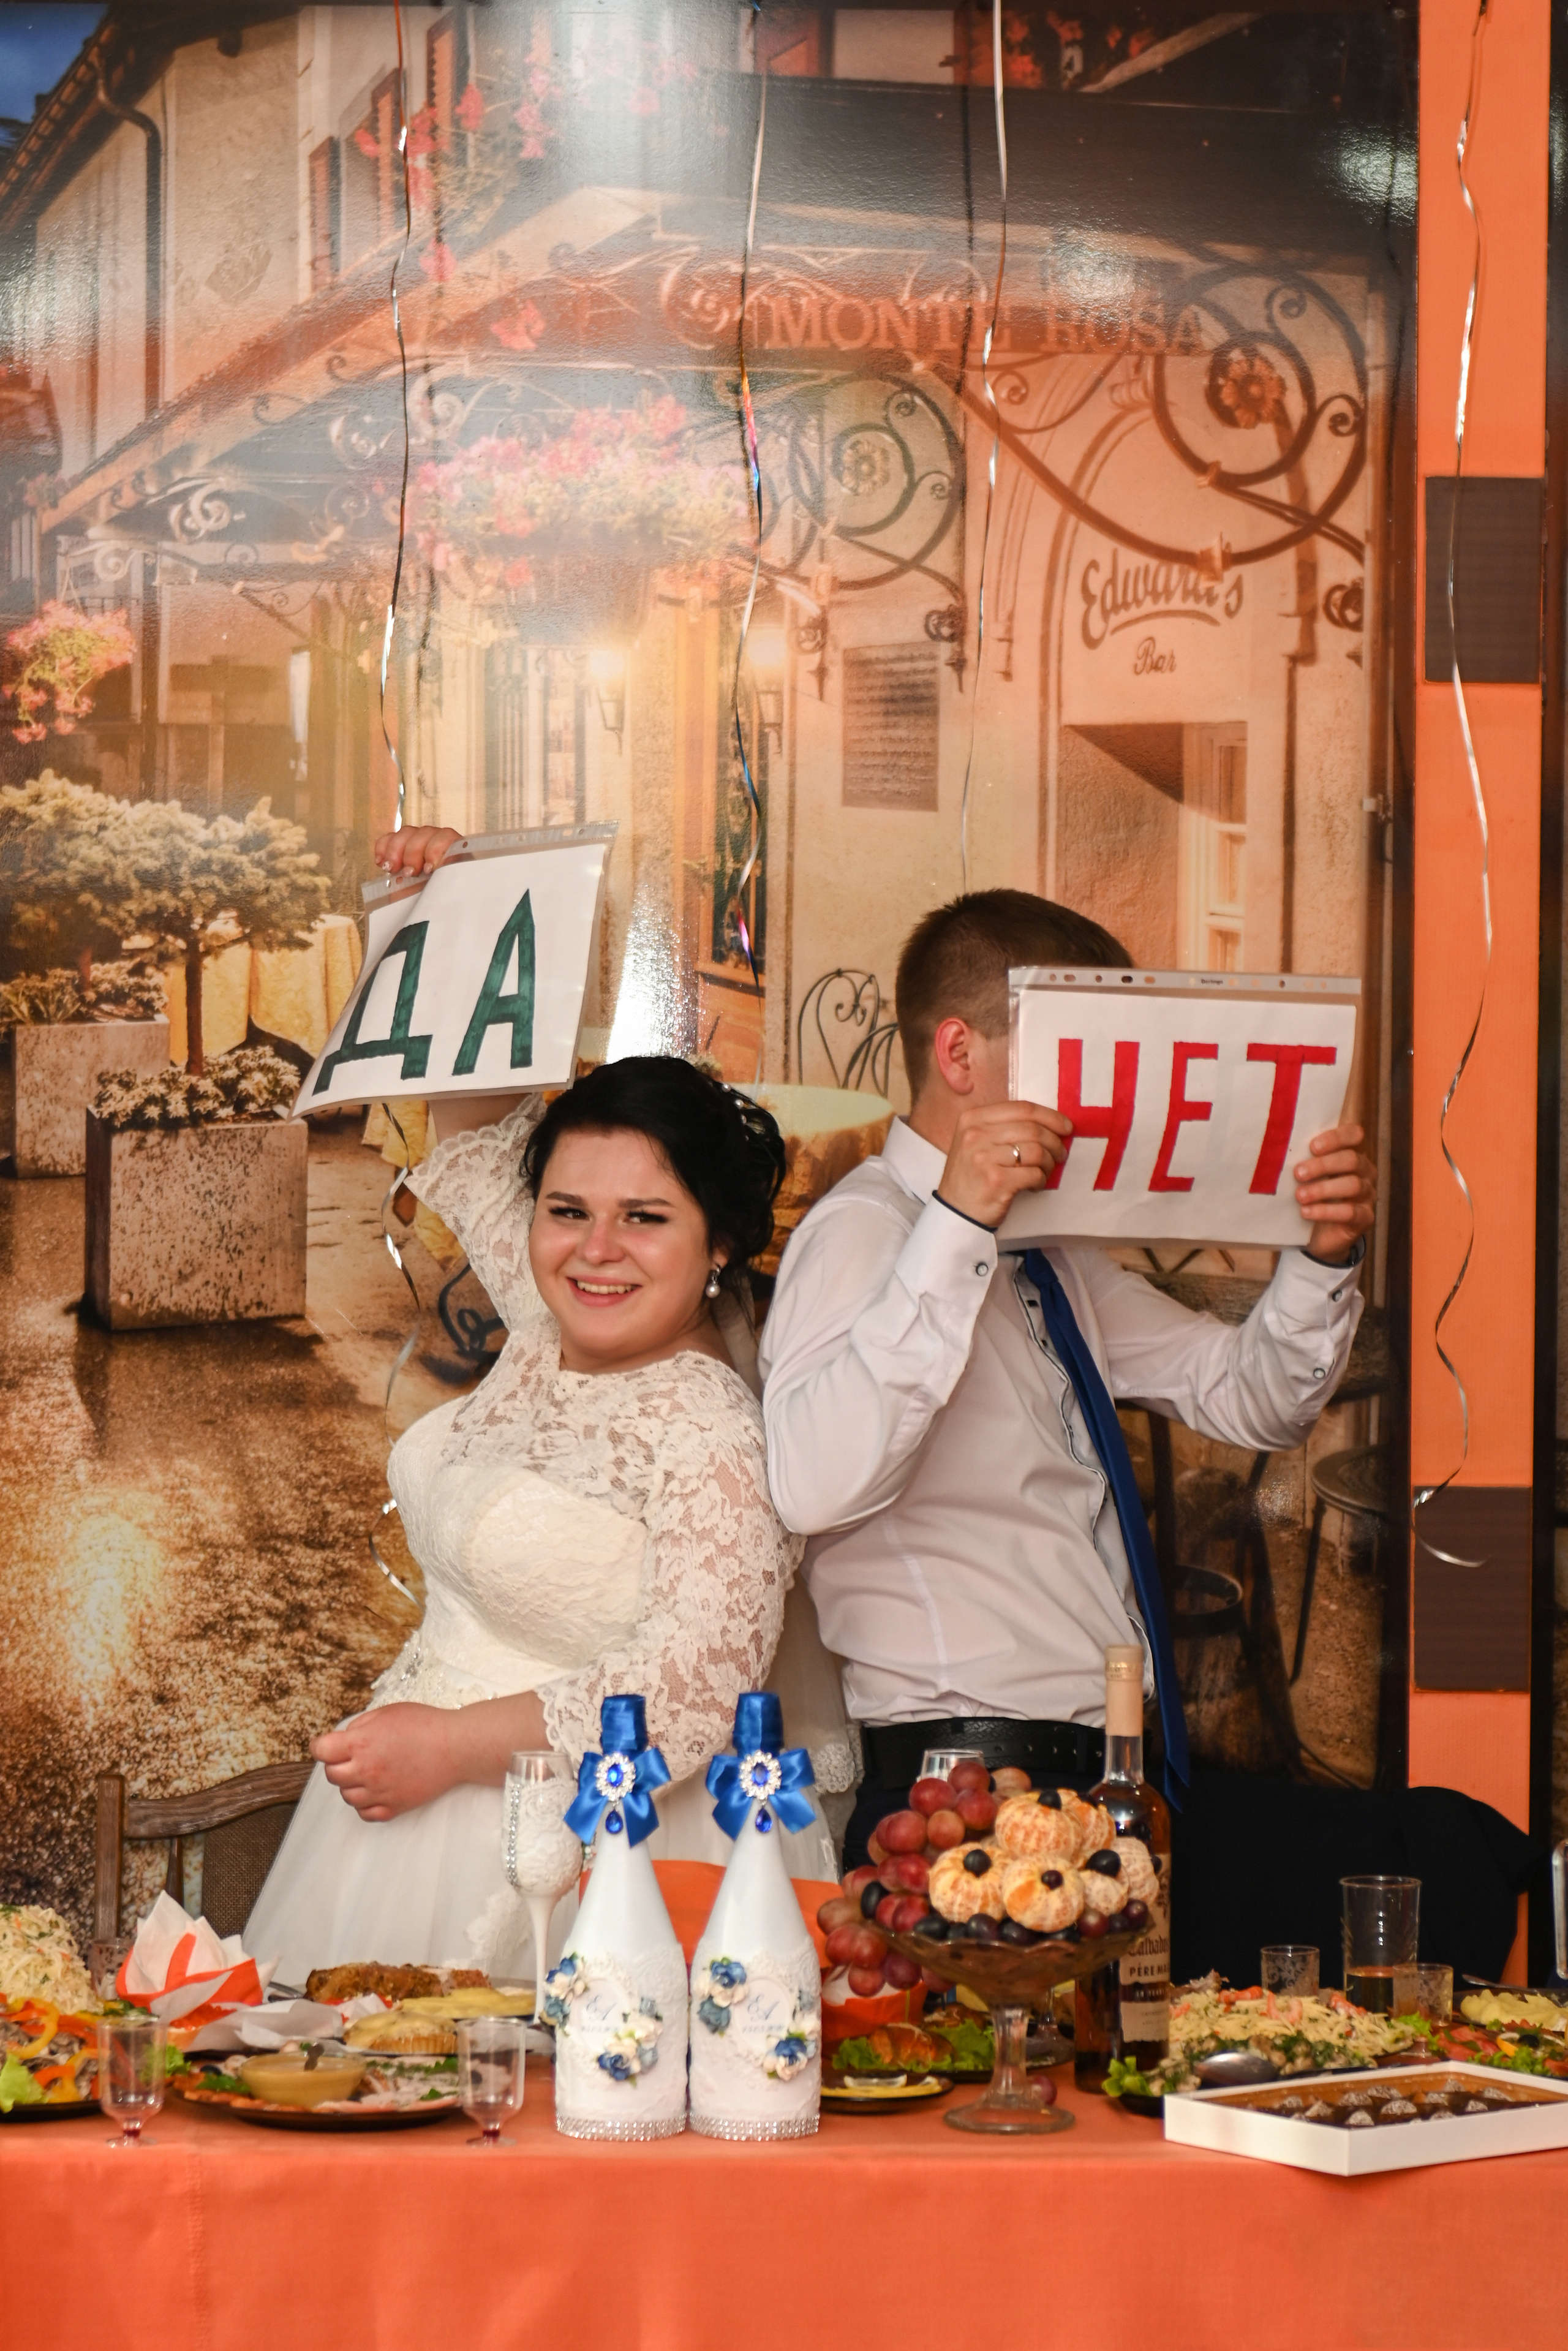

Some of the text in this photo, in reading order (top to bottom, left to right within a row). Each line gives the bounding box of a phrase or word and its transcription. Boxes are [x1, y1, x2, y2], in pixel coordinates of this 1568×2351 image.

[764, 295, 1012, 351] MONTE
[1134, 636, 1177, 675] Bar
[312, 888, 536, 1096] ДА
[1042, 1038, 1338, 1195] НЕТ
